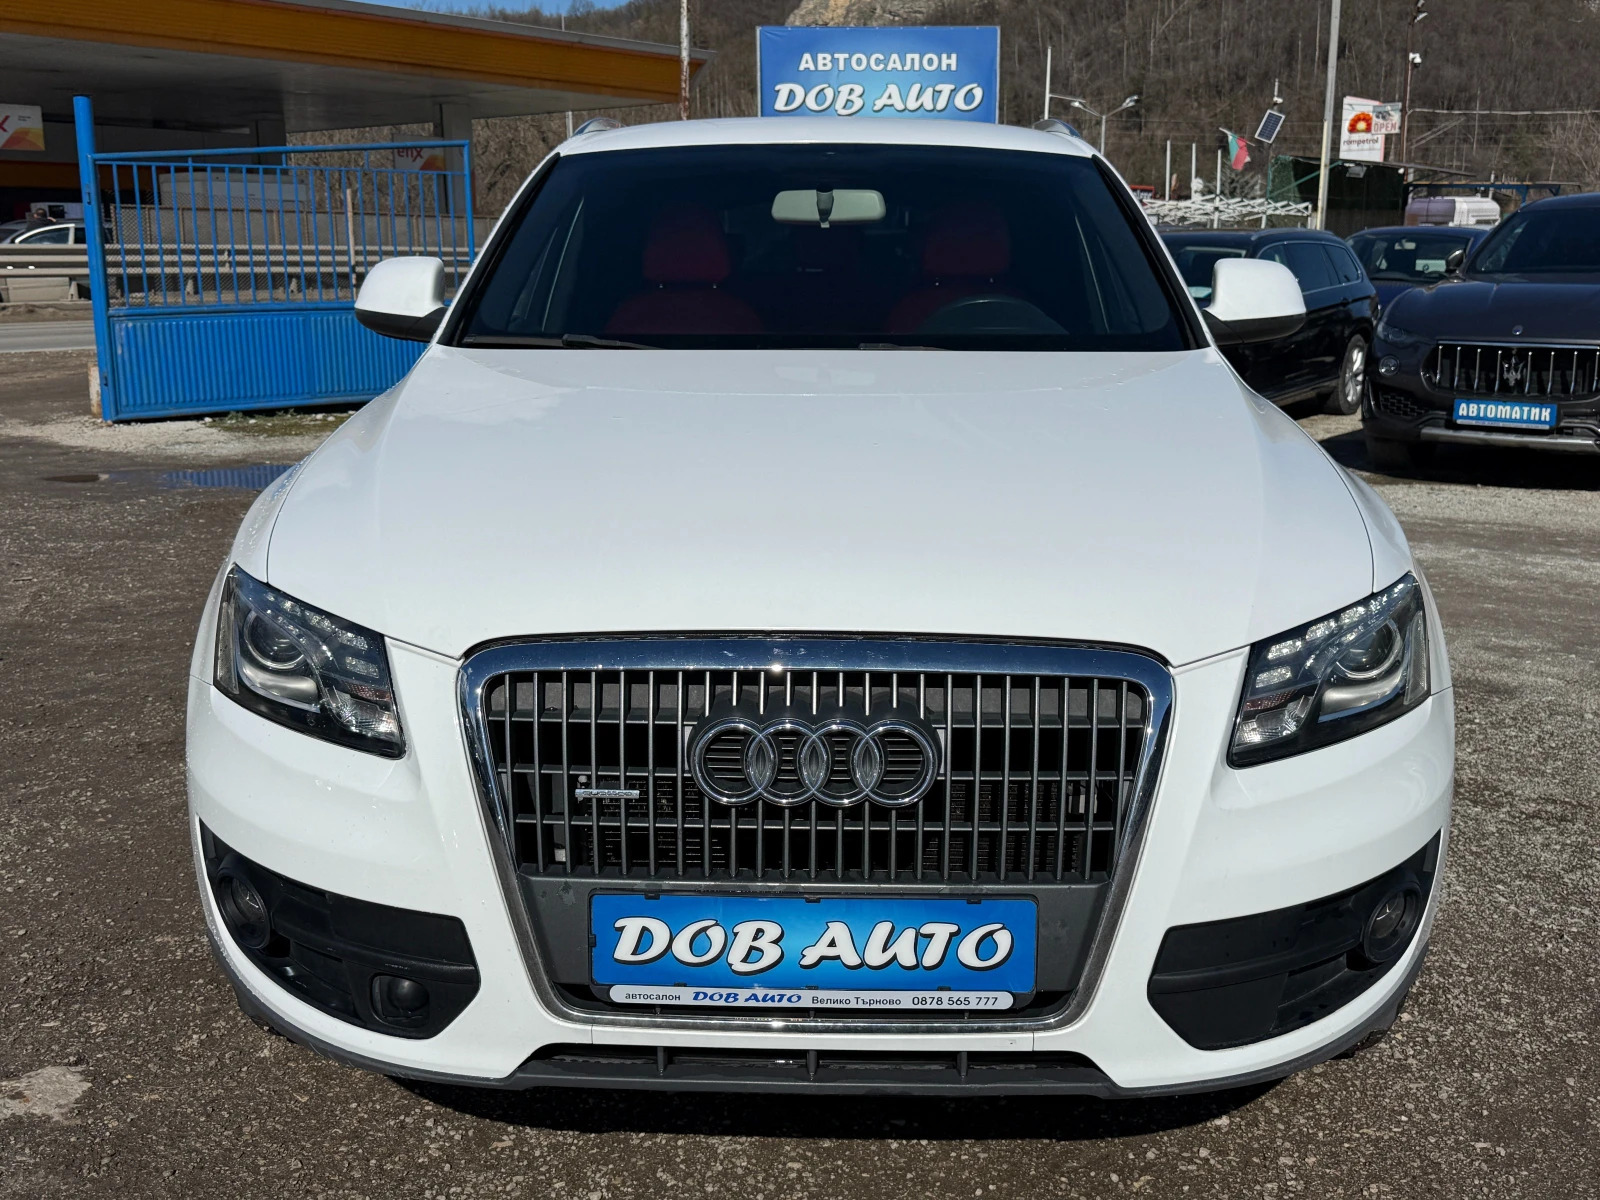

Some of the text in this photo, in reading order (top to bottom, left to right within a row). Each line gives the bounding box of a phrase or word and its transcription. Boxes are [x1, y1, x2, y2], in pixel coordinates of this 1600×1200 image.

[798, 53, 958, 72] АВТОСАЛОН
[774, 83, 984, 117] DOB AUTO
[1373, 121, 1397, 133] OPEN
[1343, 137, 1378, 147] rompetrol
[1458, 403, 1551, 422] АВТОМАТИК
[613, 916, 1014, 977] DOB AUTO
[625, 990, 998, 1007] автосалон DOB AUTO Велико Търново 0878 565 777
